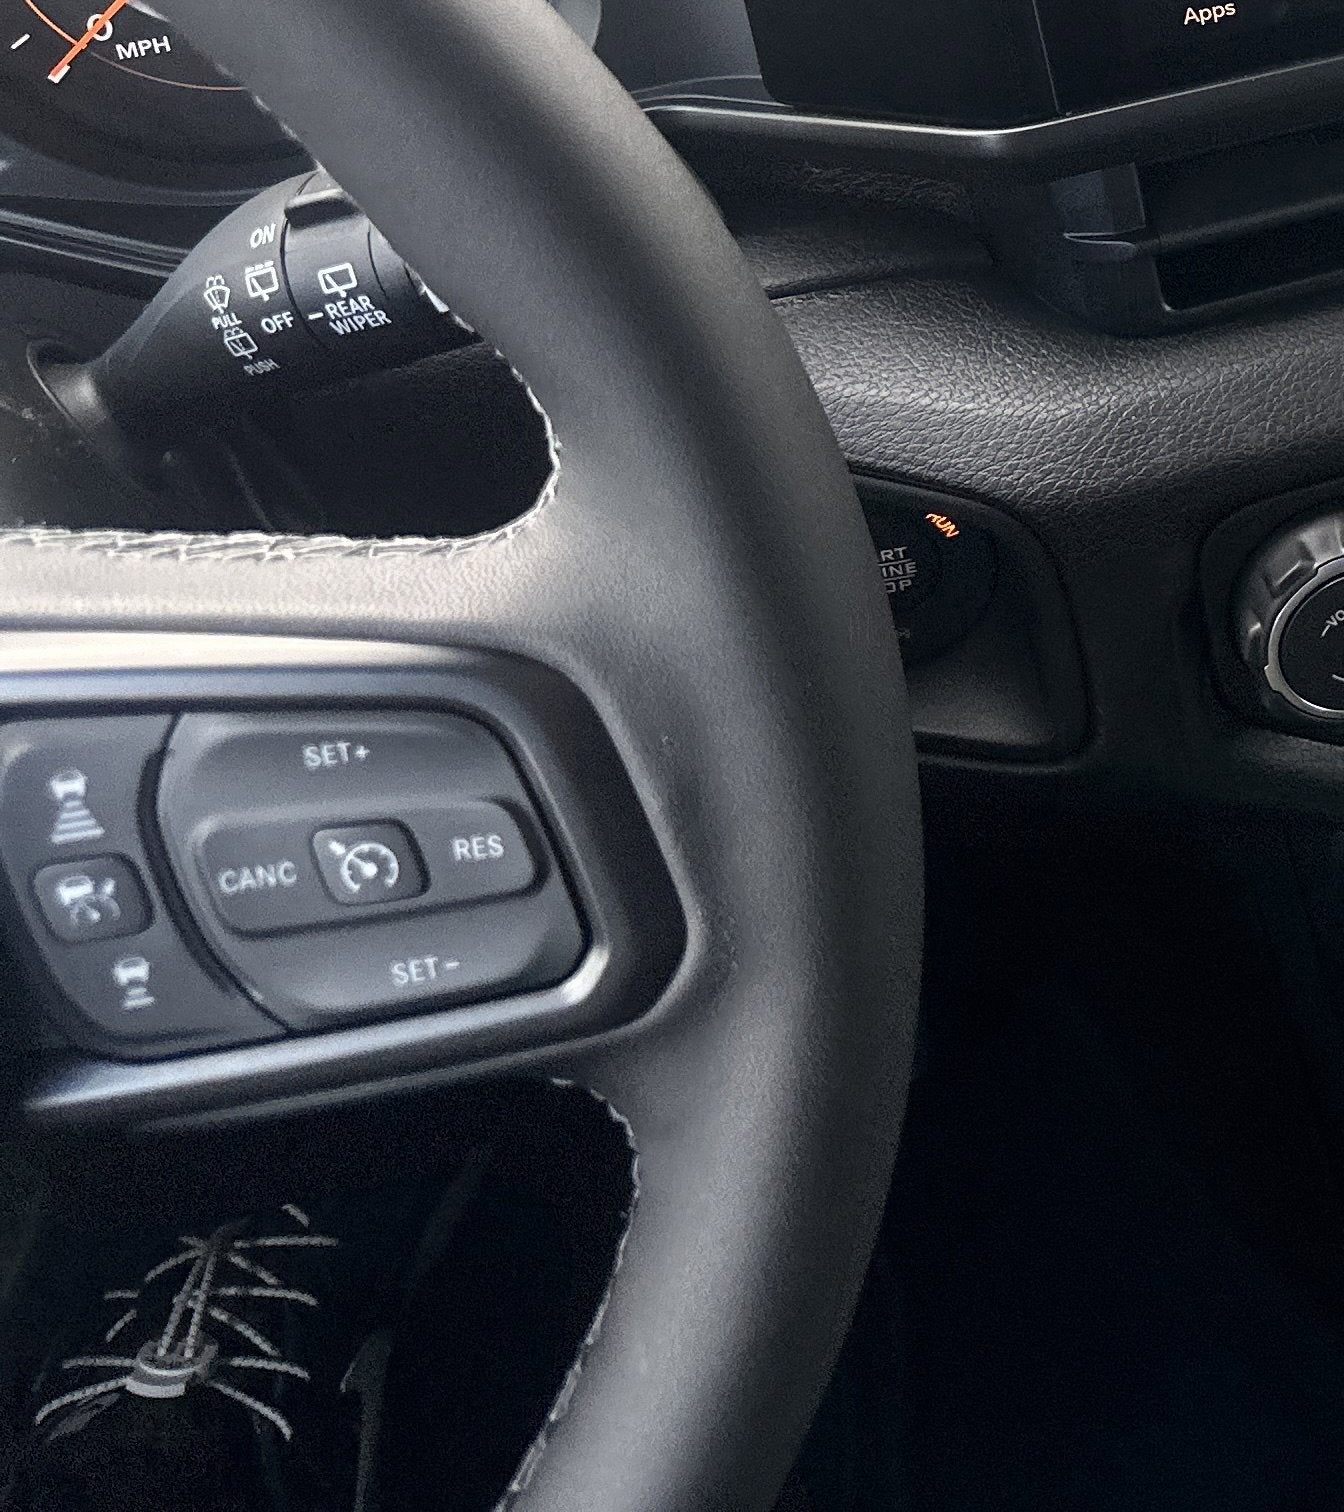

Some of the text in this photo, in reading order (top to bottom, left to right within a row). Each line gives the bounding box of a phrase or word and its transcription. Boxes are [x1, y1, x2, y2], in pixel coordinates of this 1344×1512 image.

[1183, 0, 1236, 26] Apps
[86, 14, 113, 42] 0
[116, 35, 171, 61] MPH
[250, 223, 275, 249] ON
[325, 295, 375, 318] REAR
[212, 314, 242, 331] PULL
[261, 312, 293, 334] OFF
[329, 310, 392, 336] WIPER
[244, 358, 280, 376] PUSH
[925, 513, 960, 538] RUN
[452, 835, 504, 862] RES
[218, 862, 298, 894] CANC
